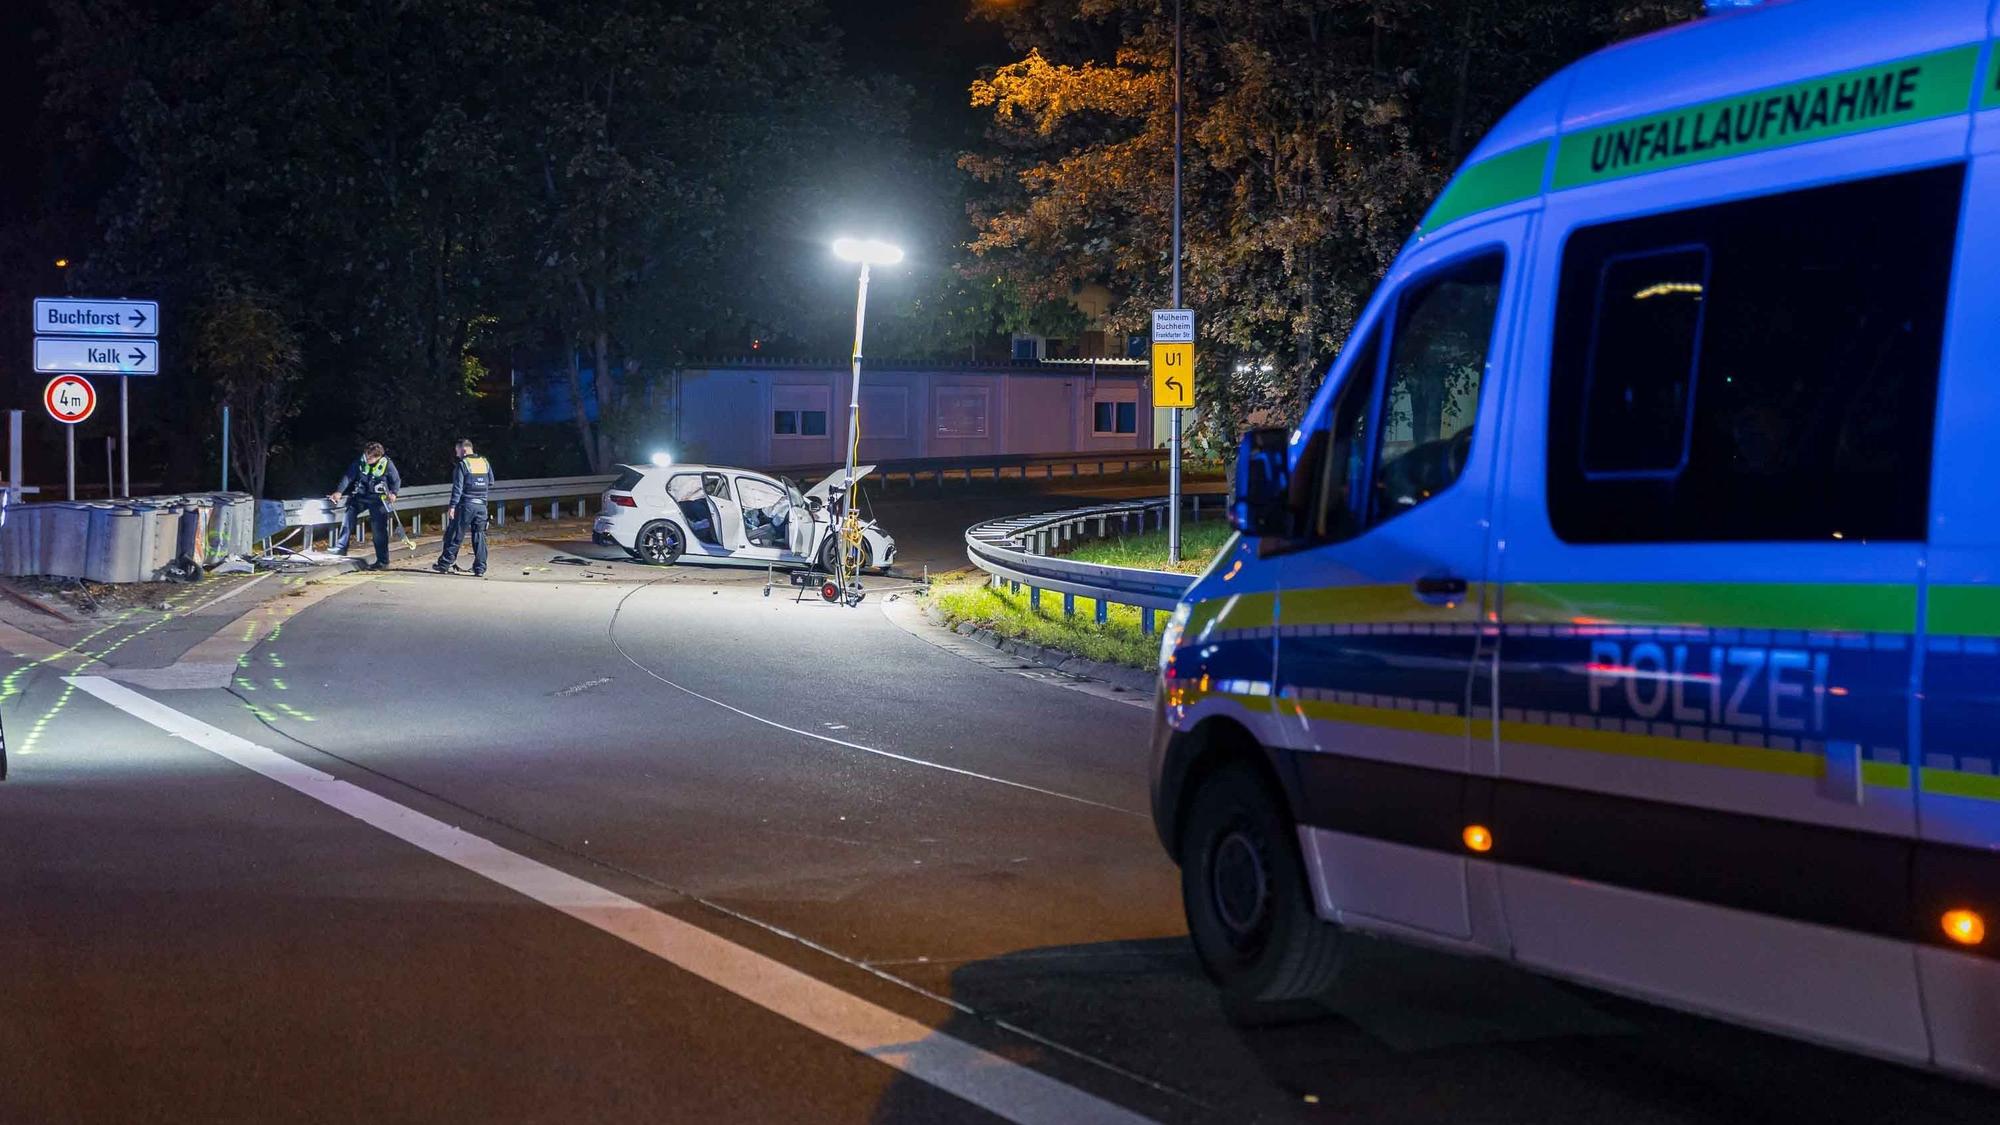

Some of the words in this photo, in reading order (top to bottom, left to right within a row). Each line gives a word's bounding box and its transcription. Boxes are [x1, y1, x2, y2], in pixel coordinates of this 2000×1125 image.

[1591, 67, 1921, 172] UNFALLAUFNAHME
[48, 309, 121, 325] Buchforst
[1156, 322, 1190, 330] Buchheim
[88, 348, 120, 363] Kalk
[1165, 353, 1181, 367] U1
[1588, 641, 1829, 732] POLIZEI
